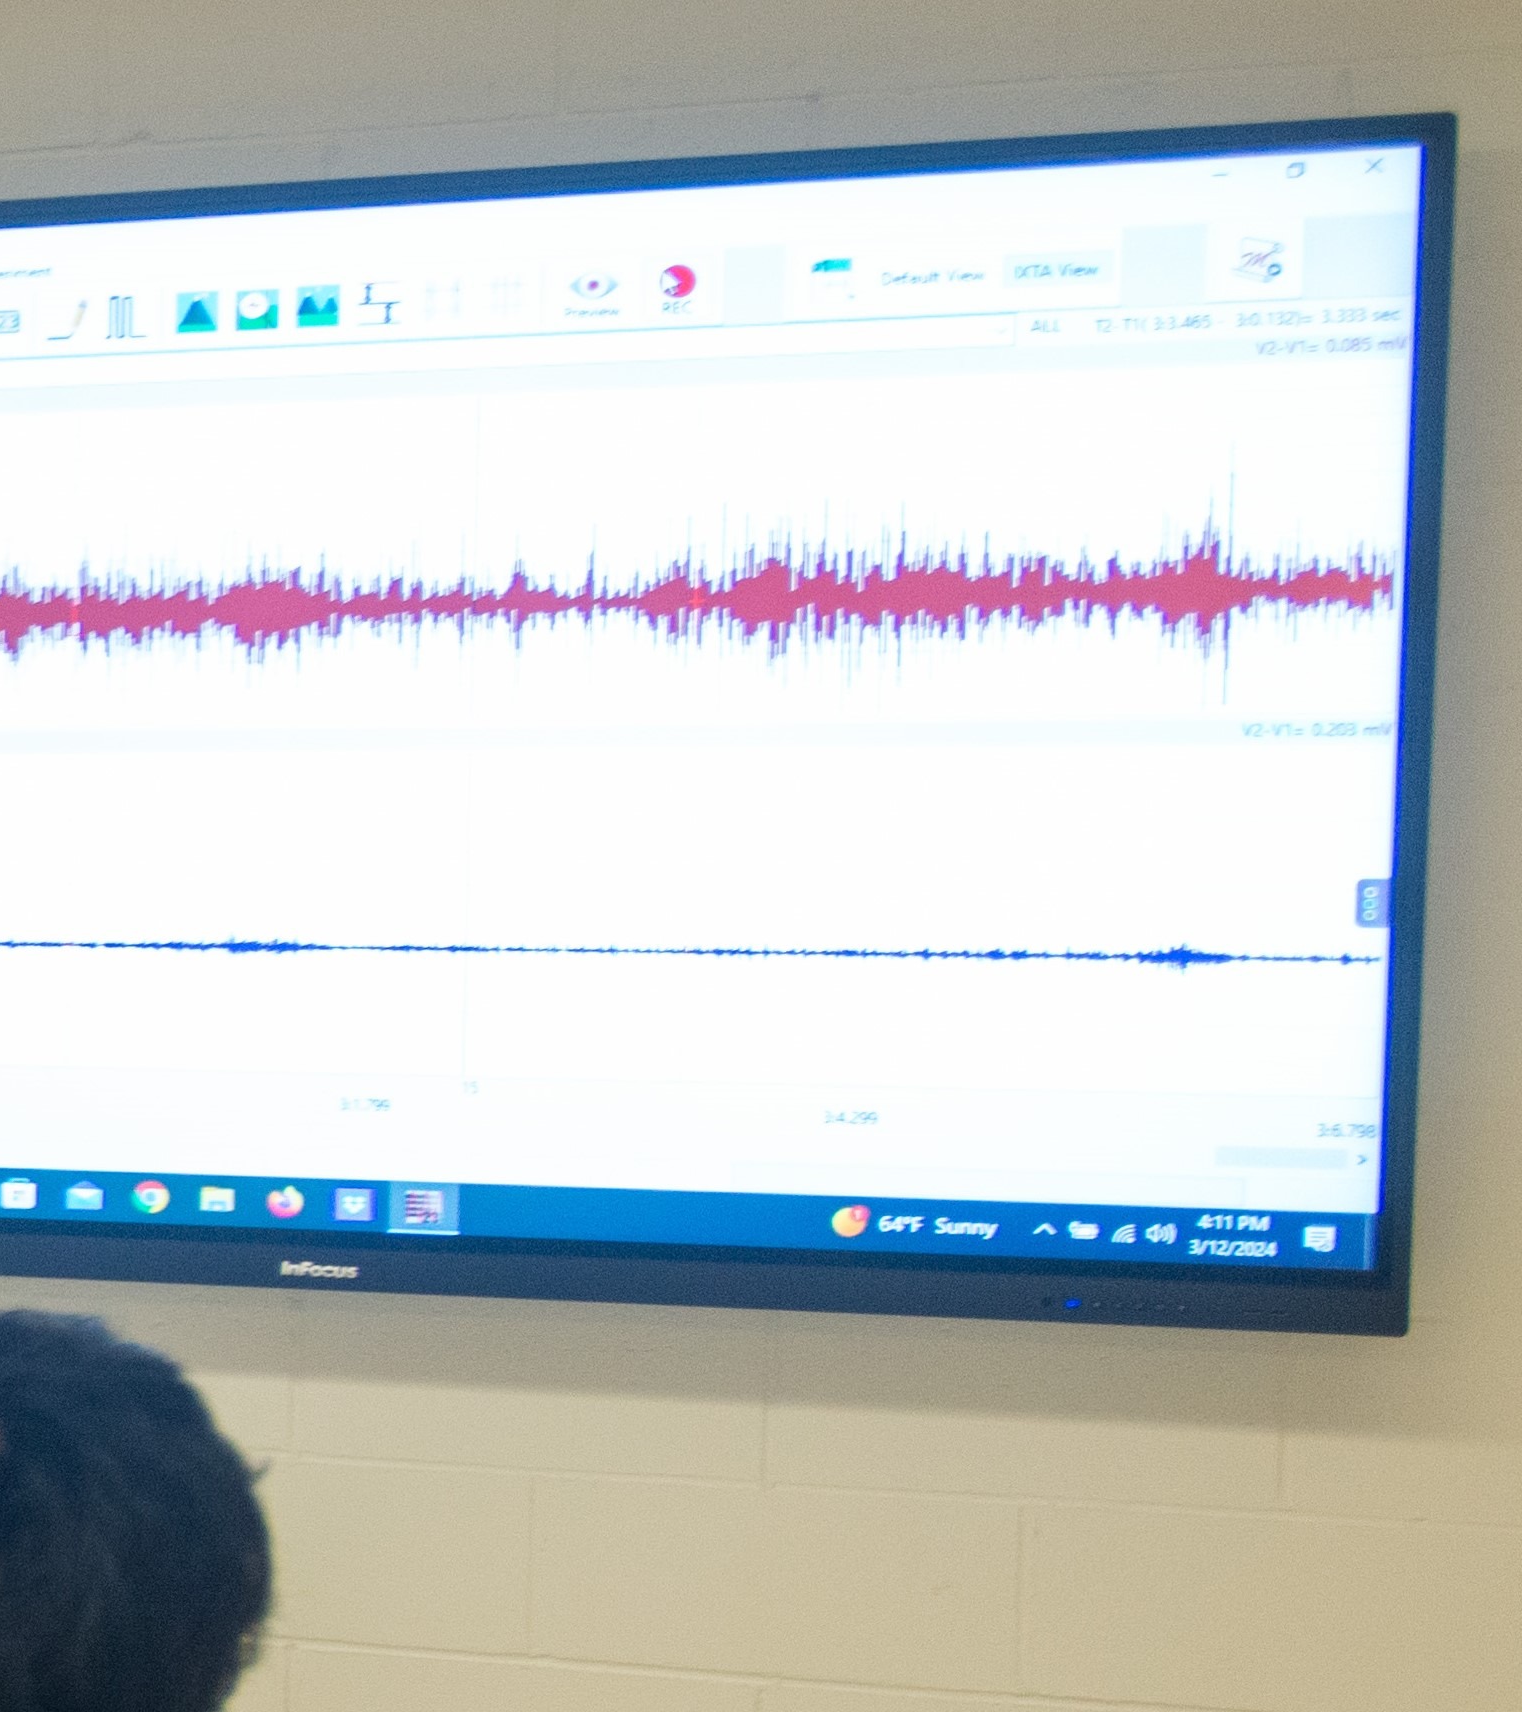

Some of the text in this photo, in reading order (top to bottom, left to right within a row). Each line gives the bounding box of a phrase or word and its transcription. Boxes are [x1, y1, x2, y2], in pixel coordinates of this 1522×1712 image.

[946, 268, 986, 282] View
[1058, 261, 1100, 278] View
[1029, 318, 1062, 334] ALL
[933, 1216, 1000, 1239] Sunny
[1195, 1213, 1271, 1232] 4:11 PM
[1188, 1238, 1278, 1257] 3/12/2024
[279, 1259, 360, 1280] InFocus
